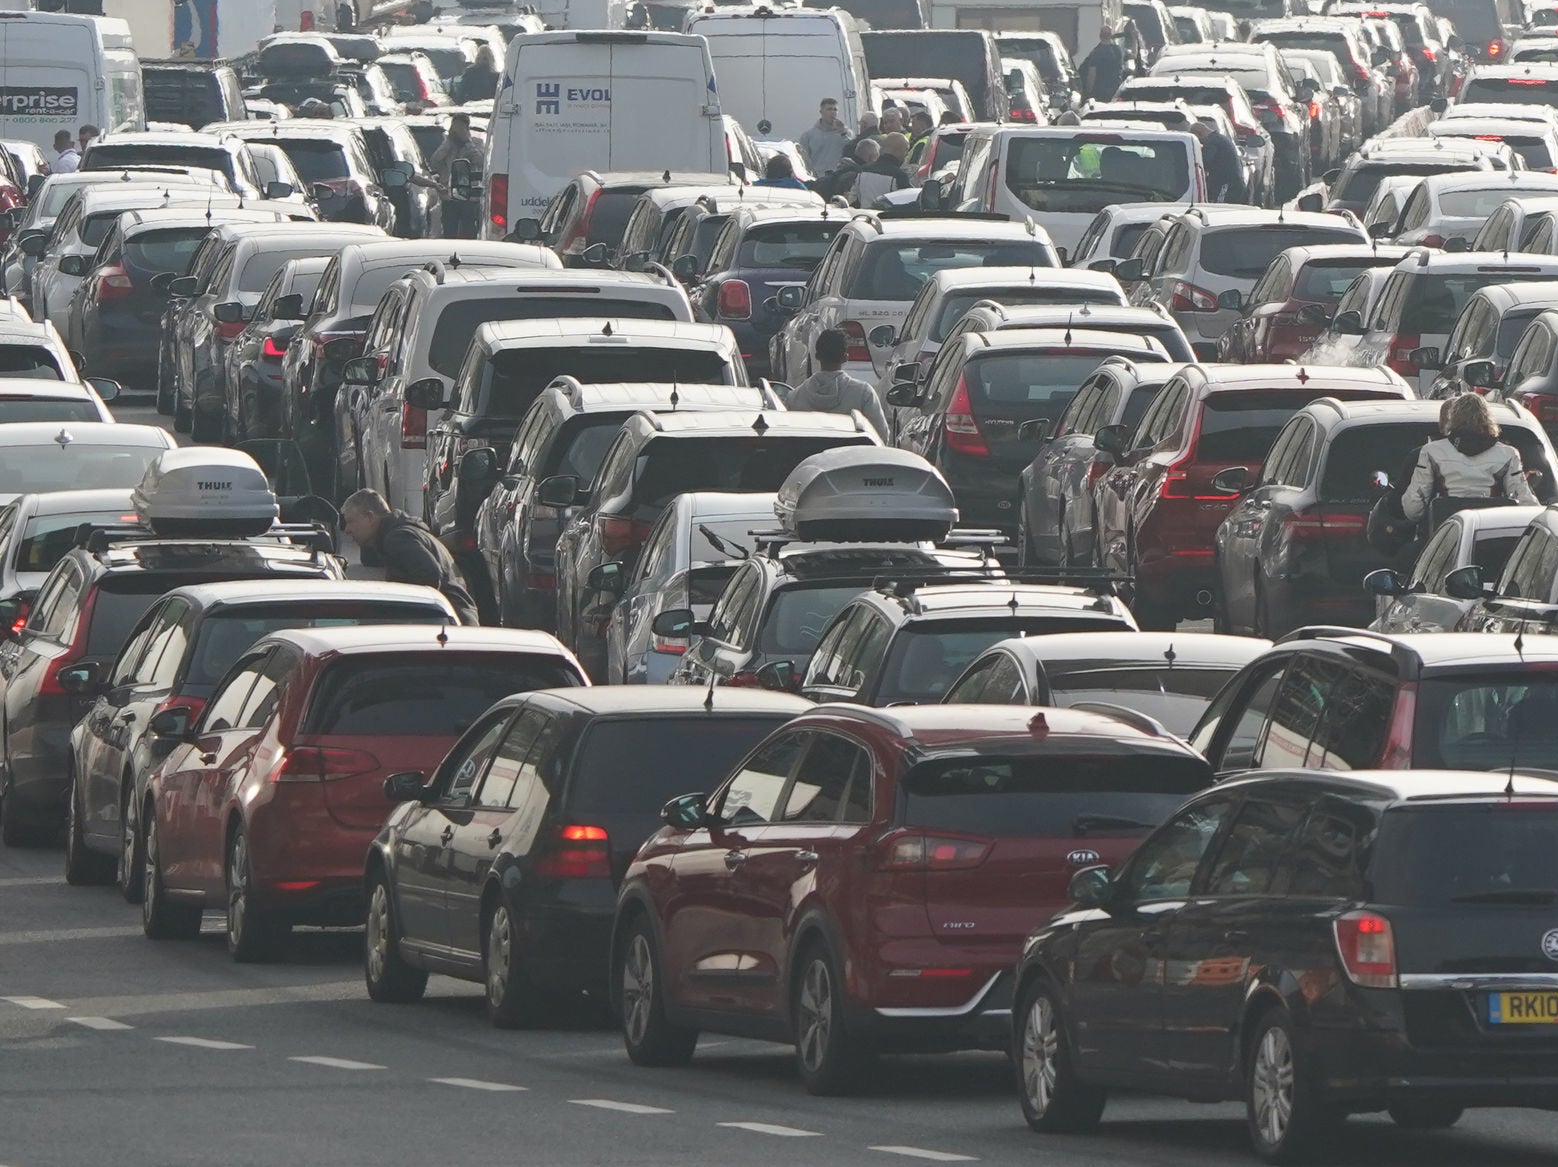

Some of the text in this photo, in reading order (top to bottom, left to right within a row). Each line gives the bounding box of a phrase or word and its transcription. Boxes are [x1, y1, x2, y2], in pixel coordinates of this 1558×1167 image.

[0, 91, 76, 111] rprise
[197, 481, 233, 491] THULE
[863, 478, 894, 487] THULE
[1072, 853, 1094, 862] KIA
